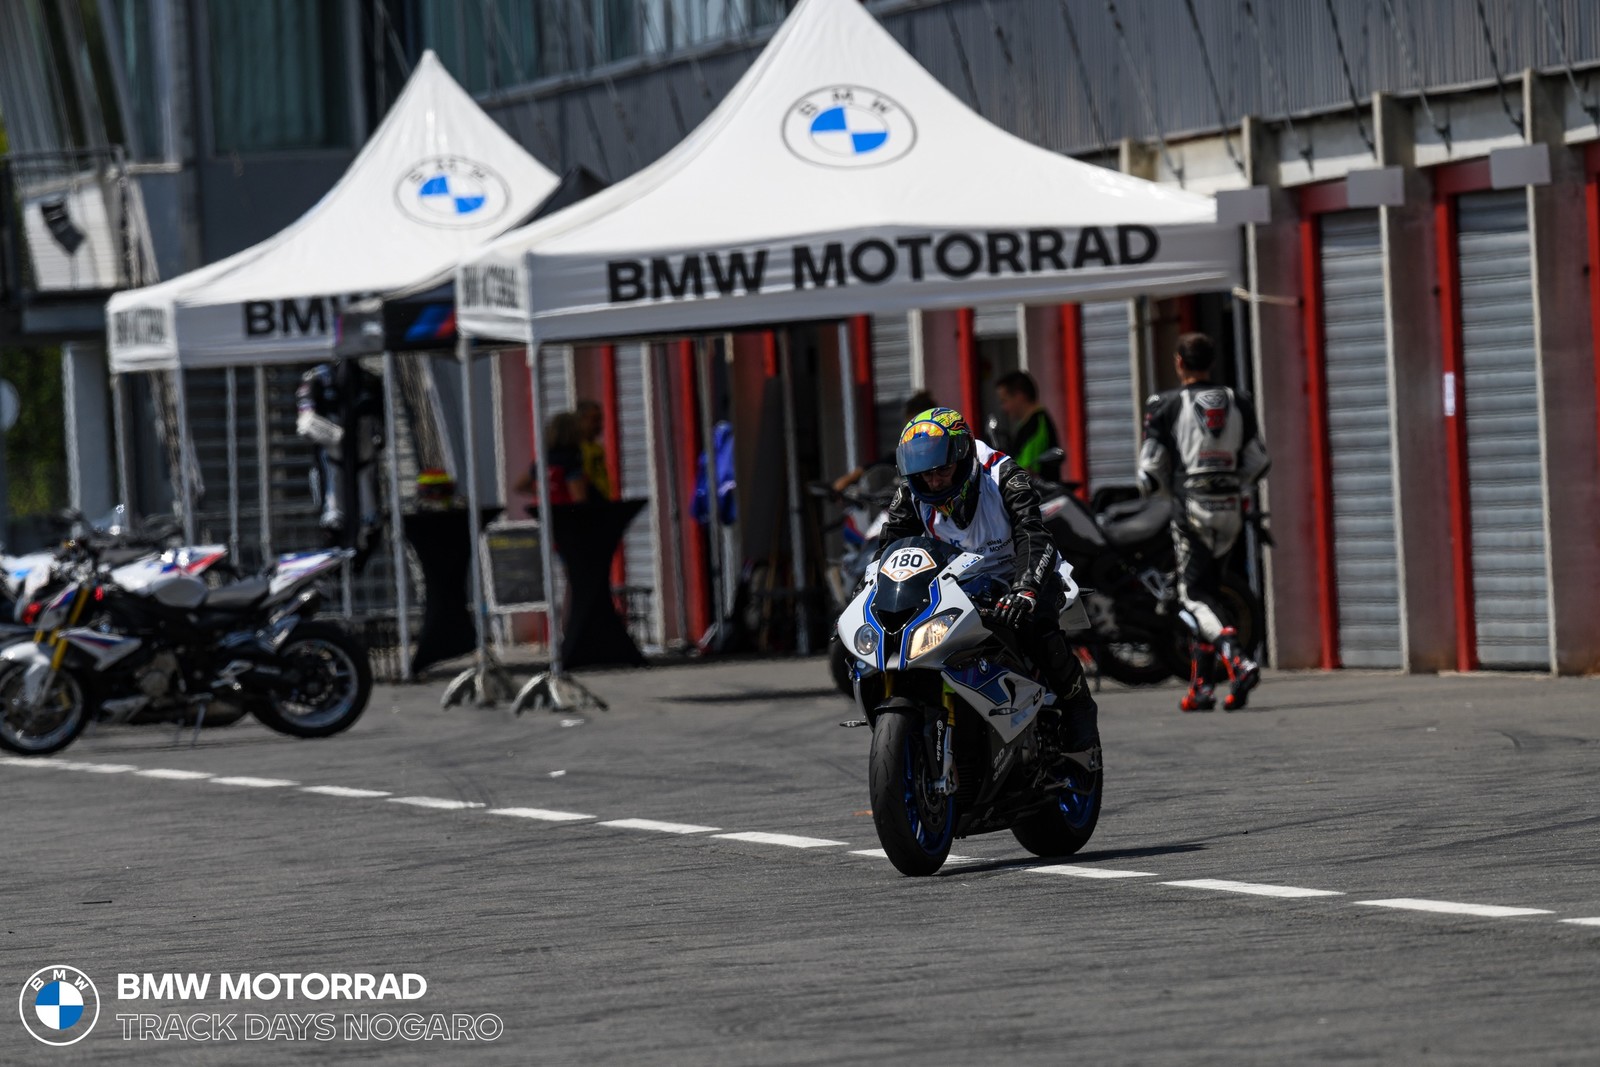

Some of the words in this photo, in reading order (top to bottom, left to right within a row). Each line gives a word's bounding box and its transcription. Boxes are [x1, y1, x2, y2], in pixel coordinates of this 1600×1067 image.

[607, 249, 769, 302] BMW
[792, 223, 1160, 290] MOTORRAD
[890, 553, 923, 569] 180
